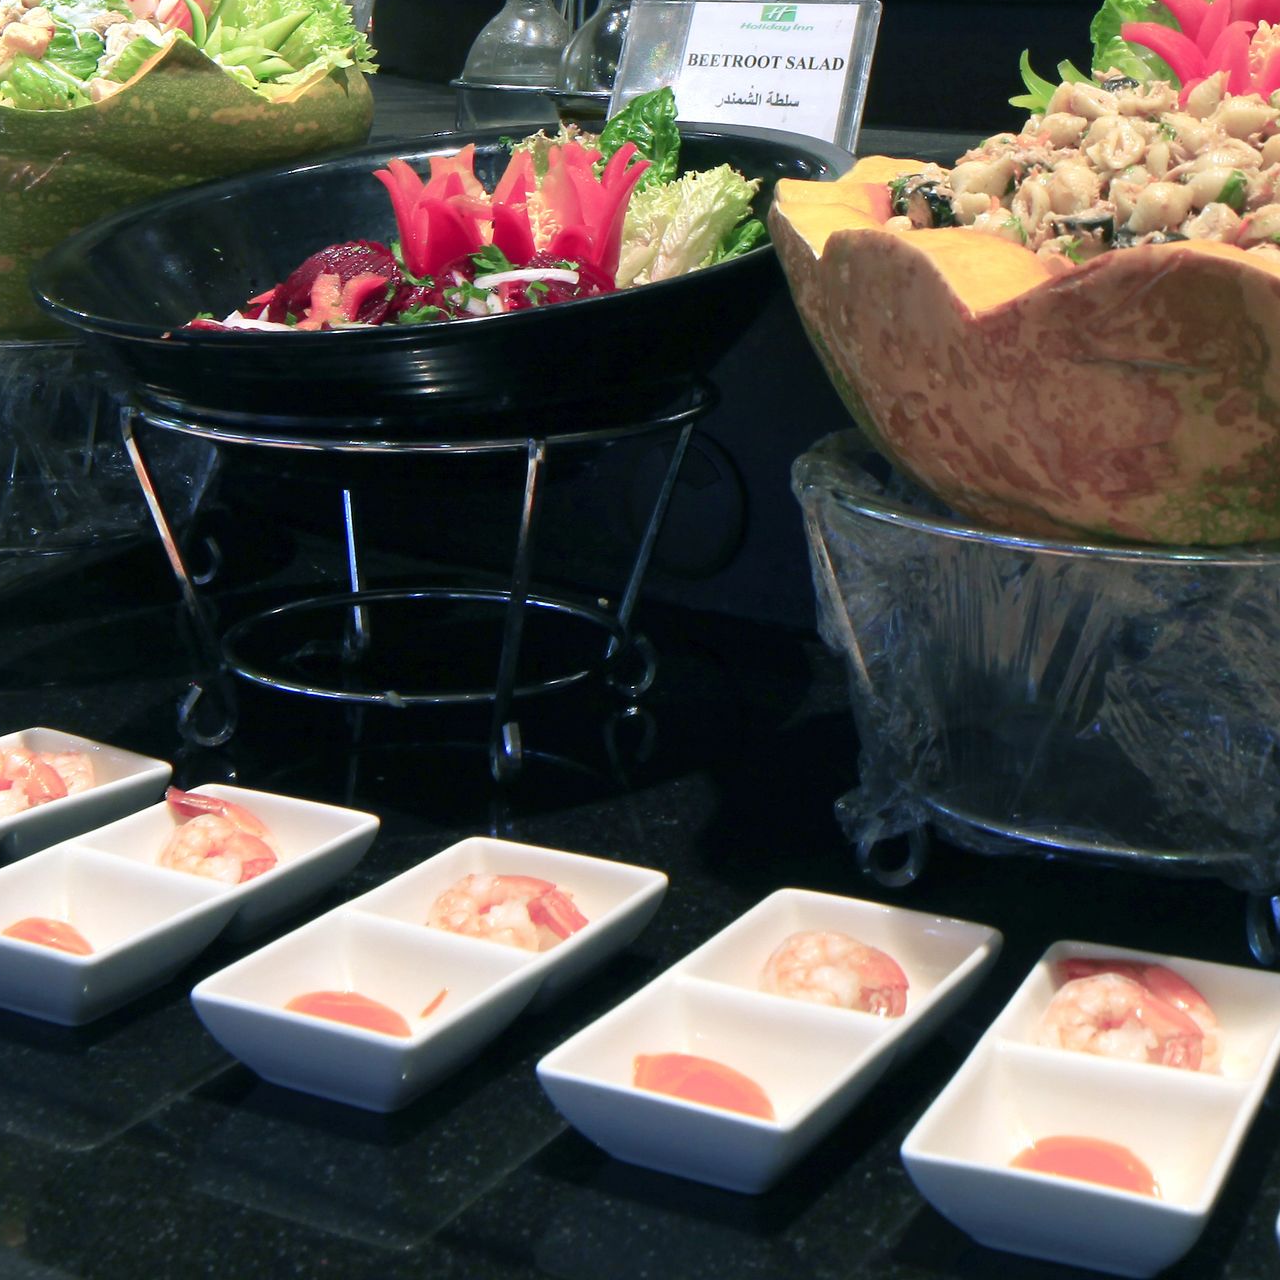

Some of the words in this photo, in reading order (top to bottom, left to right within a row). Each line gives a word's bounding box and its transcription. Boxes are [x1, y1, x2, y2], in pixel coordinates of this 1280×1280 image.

[740, 21, 791, 33] Holiday
[793, 23, 815, 32] Inn
[687, 52, 783, 70] BEETROOT
[785, 55, 845, 71] SALAD
[766, 91, 800, 107] سلطة
